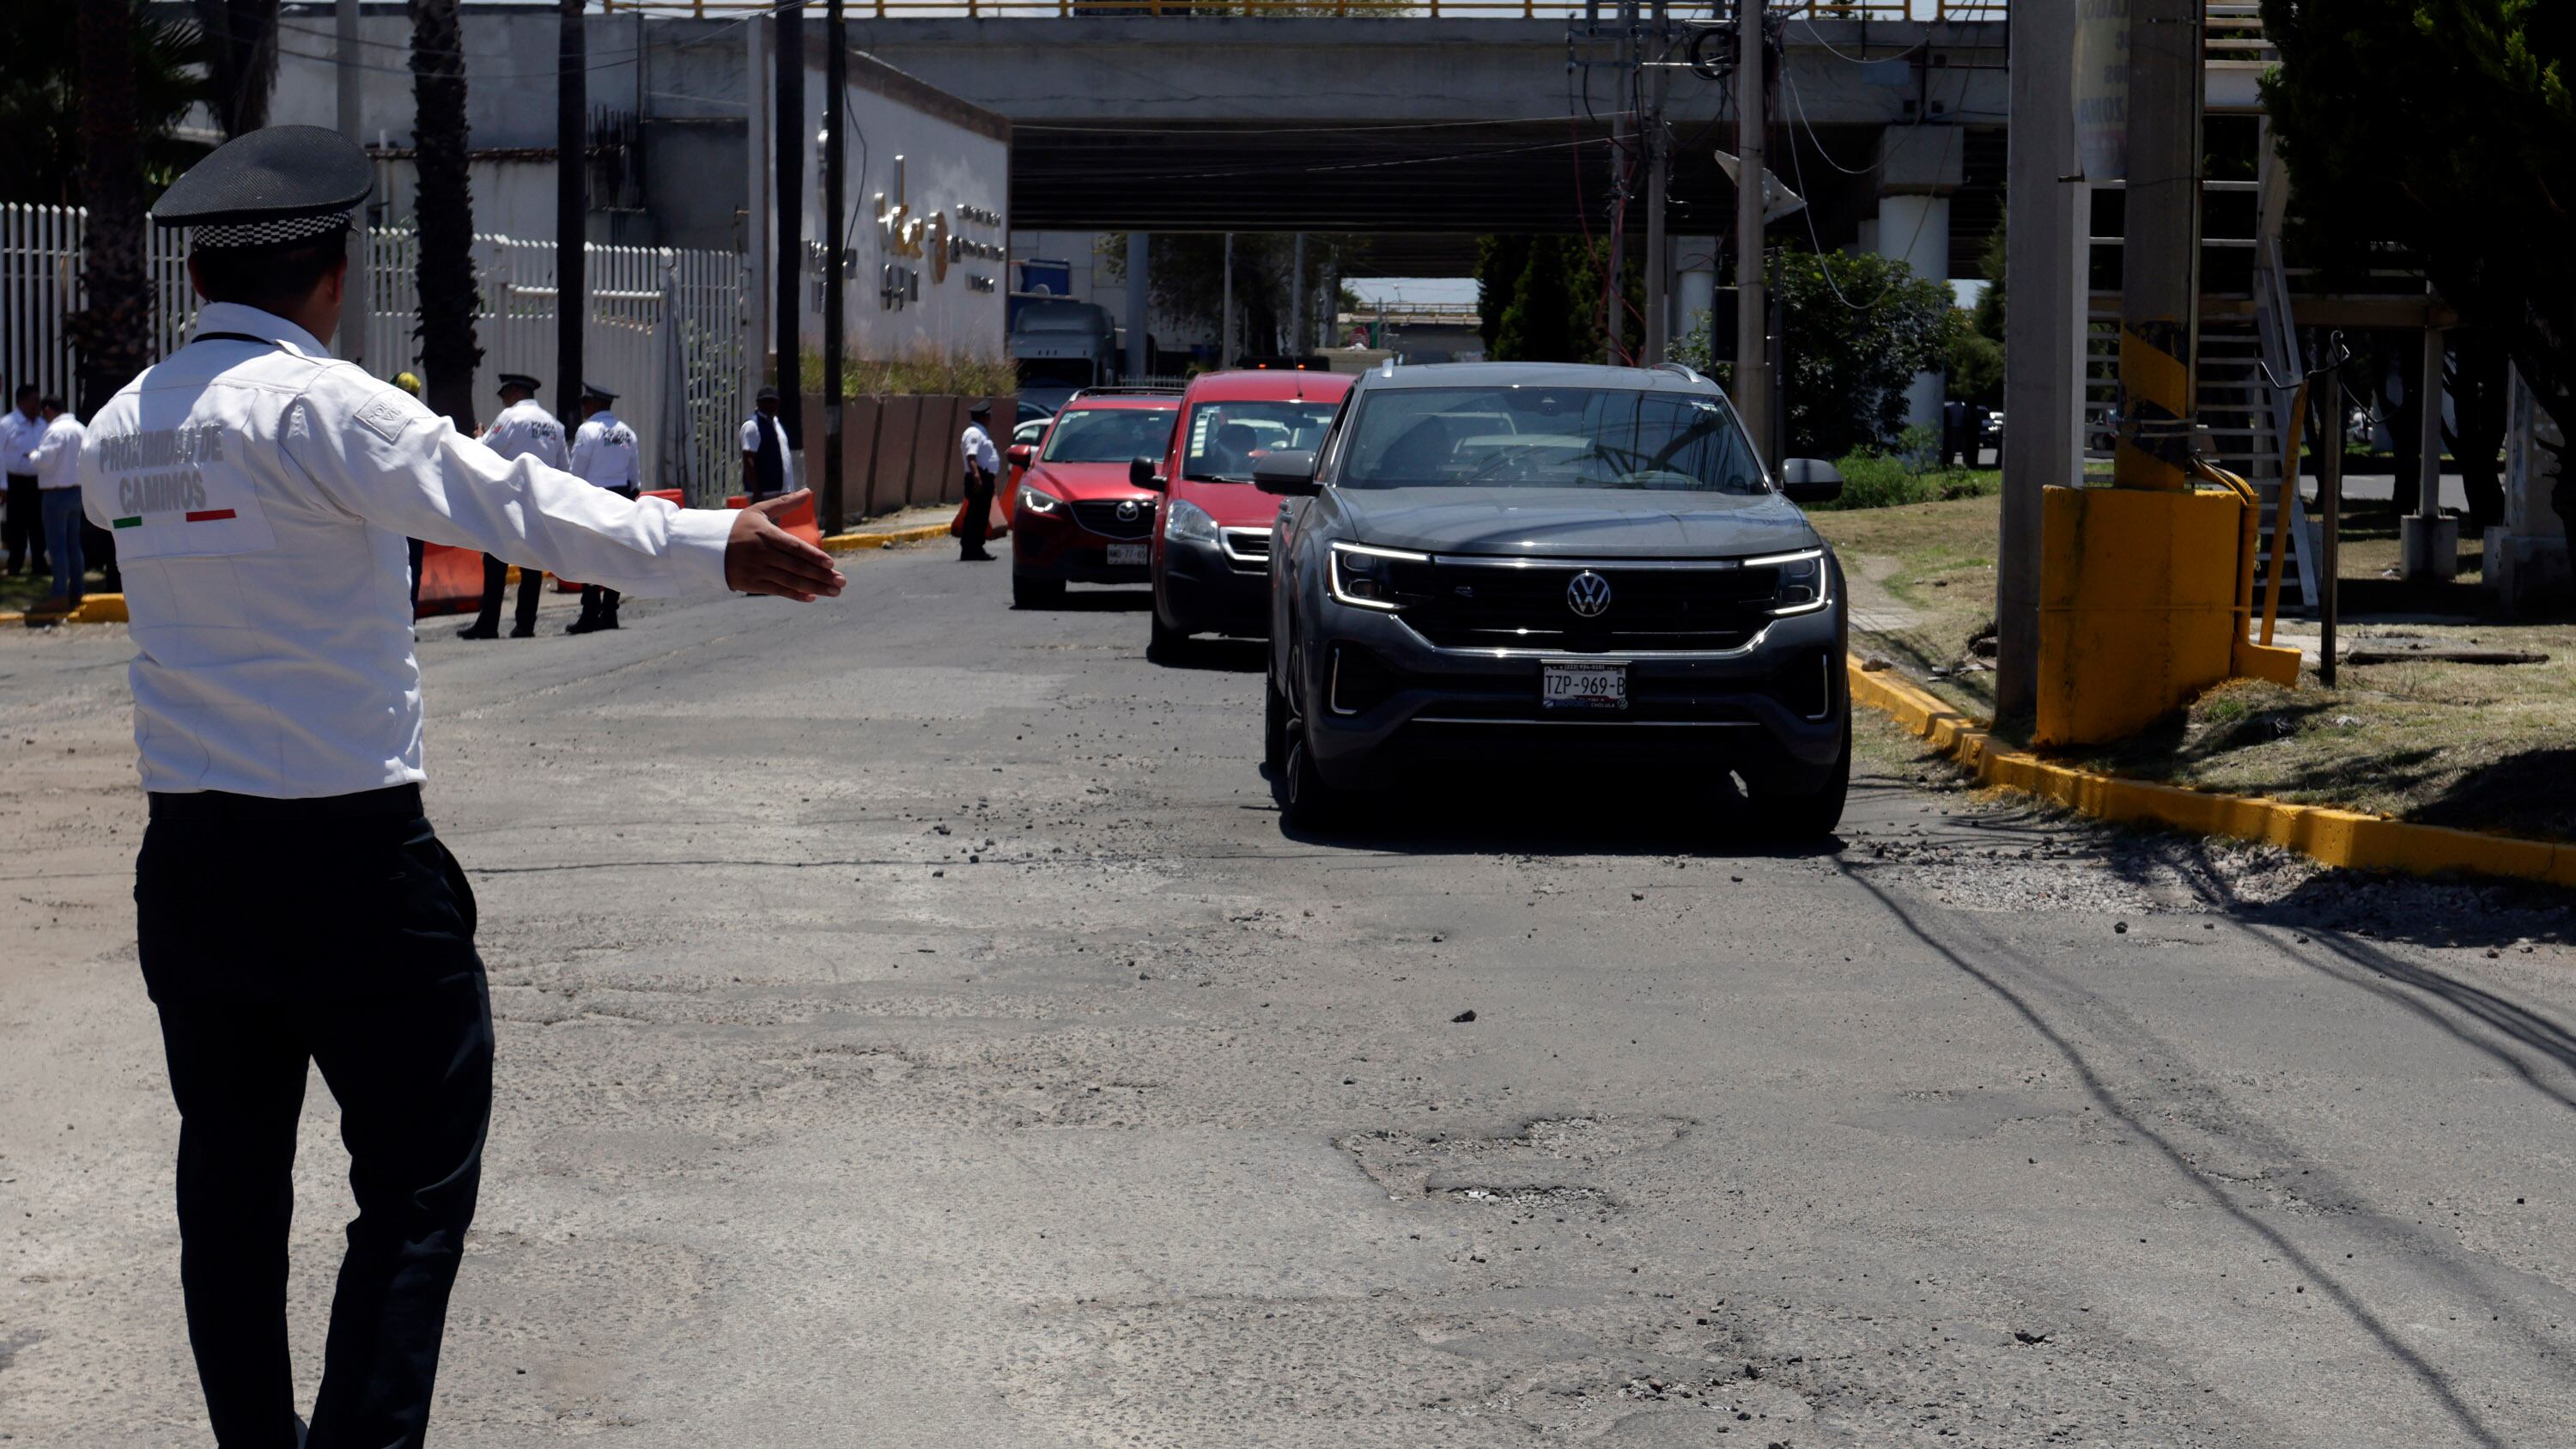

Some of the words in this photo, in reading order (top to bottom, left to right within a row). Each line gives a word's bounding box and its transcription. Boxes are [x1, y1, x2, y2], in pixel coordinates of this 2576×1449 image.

[198, 423, 224, 462] DE
[119, 469, 207, 514] CAMINOS
[1545, 675, 1625, 696] TZP-969-B
